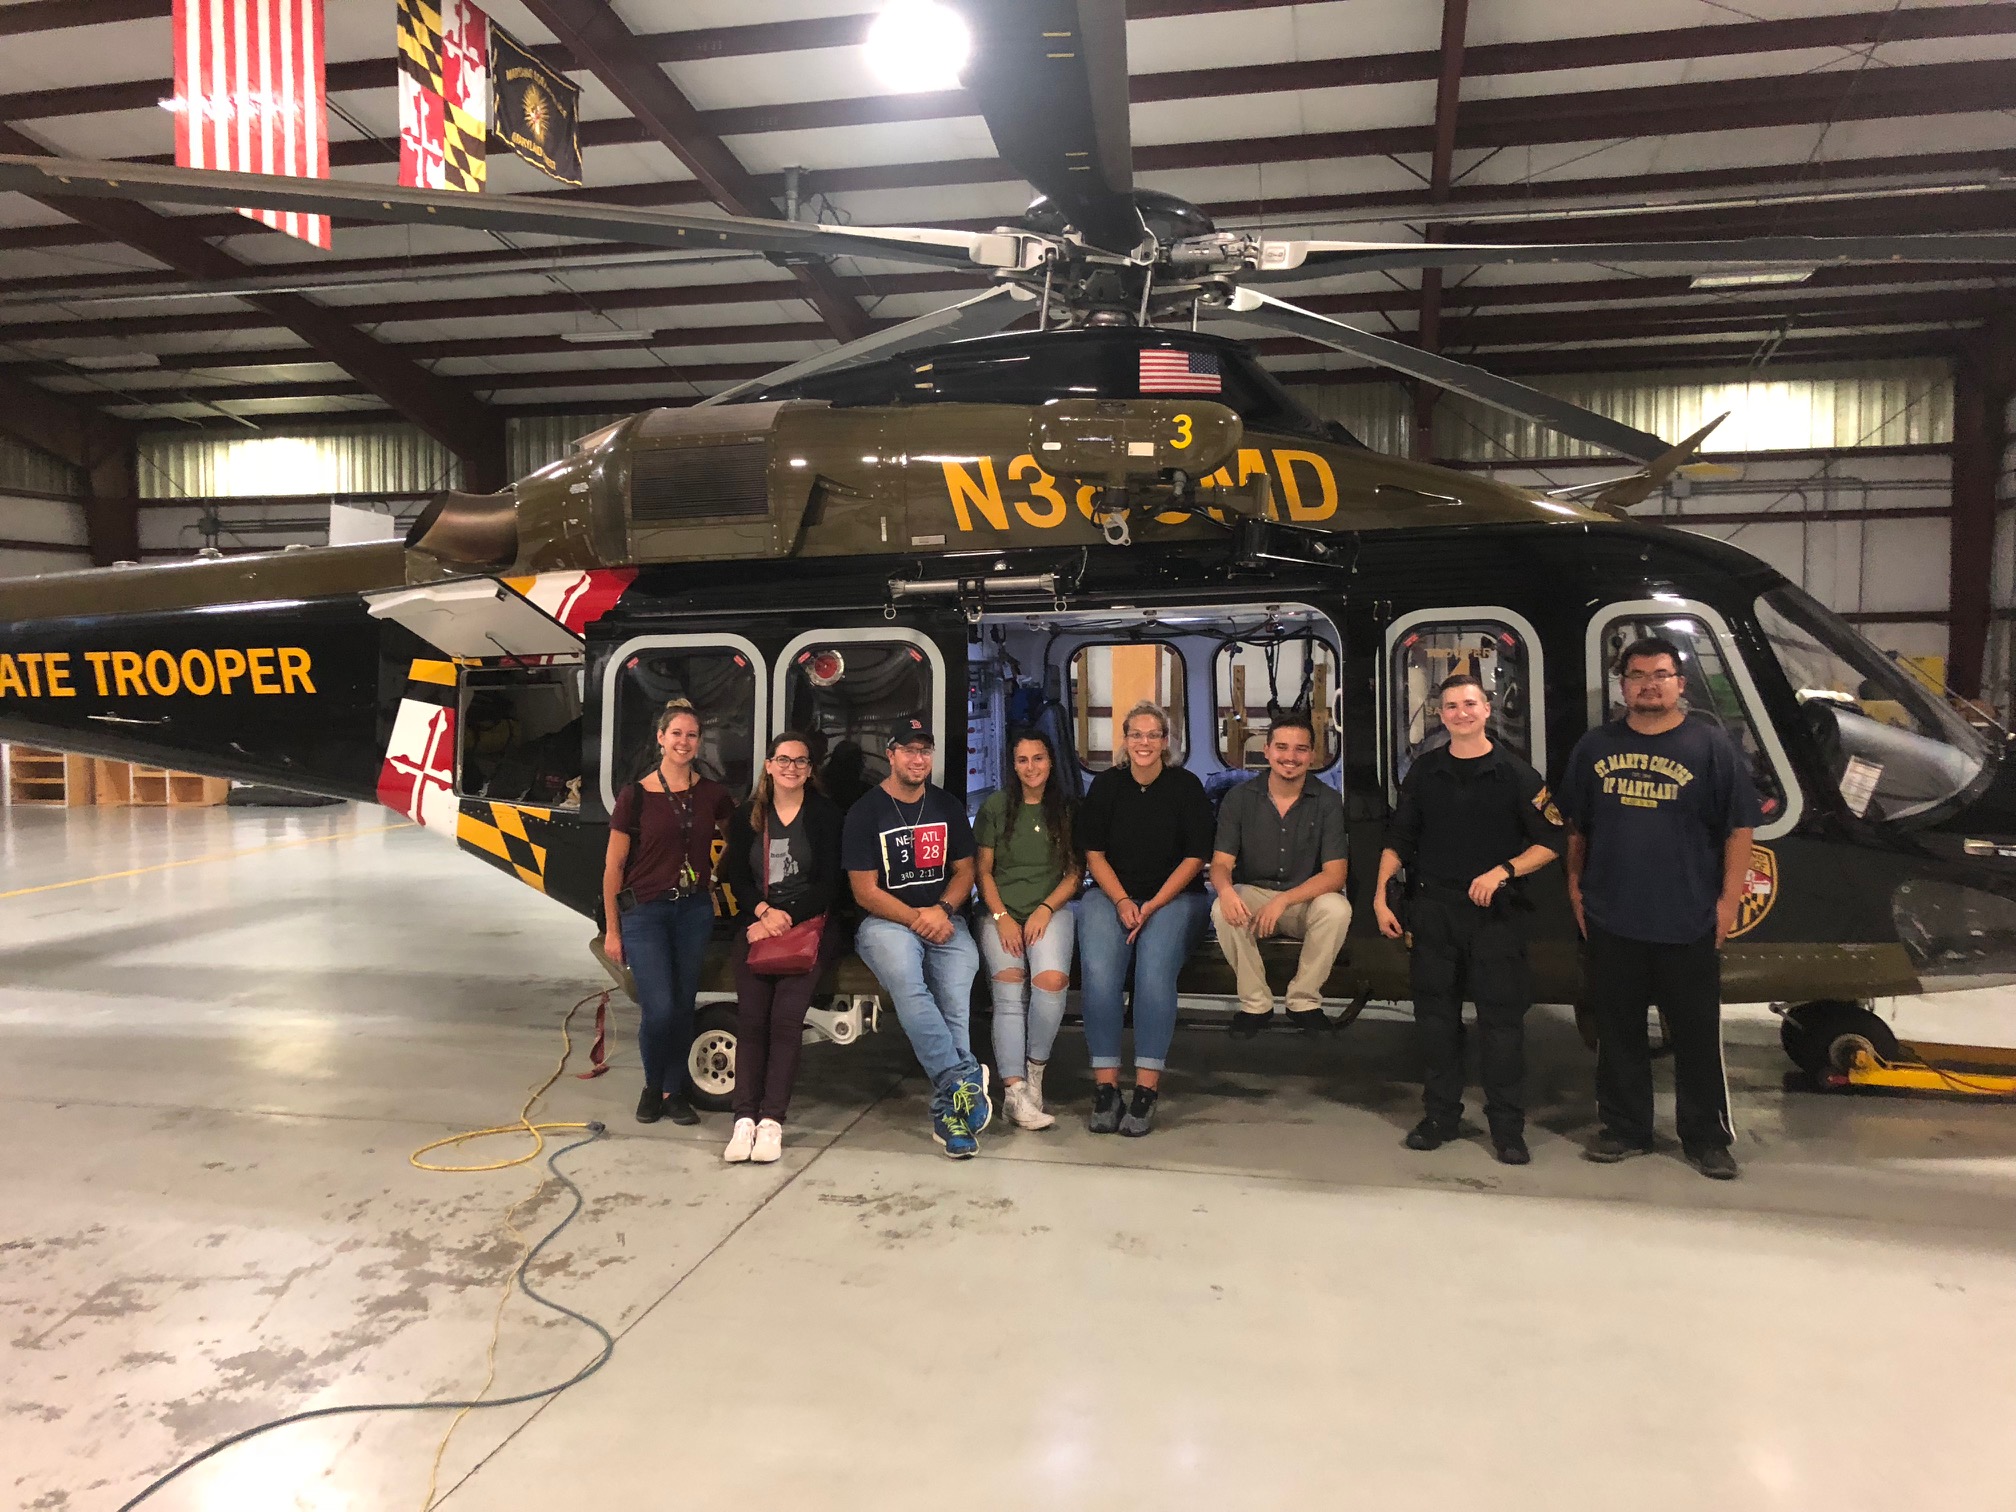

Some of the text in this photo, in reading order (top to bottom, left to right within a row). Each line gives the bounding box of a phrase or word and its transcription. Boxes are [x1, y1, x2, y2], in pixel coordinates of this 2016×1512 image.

[1169, 413, 1193, 449] 3
[941, 448, 1338, 532] N3MD
[0, 646, 318, 698] ATE TROOPER
[1607, 753, 1649, 771] MARY'S
[1649, 755, 1694, 787] COLLEGE
[1603, 777, 1679, 800] OF MARYLAND
[895, 831, 941, 847] NE ATL
[900, 844, 940, 863] 3 28
[901, 870, 915, 881] 3RD
